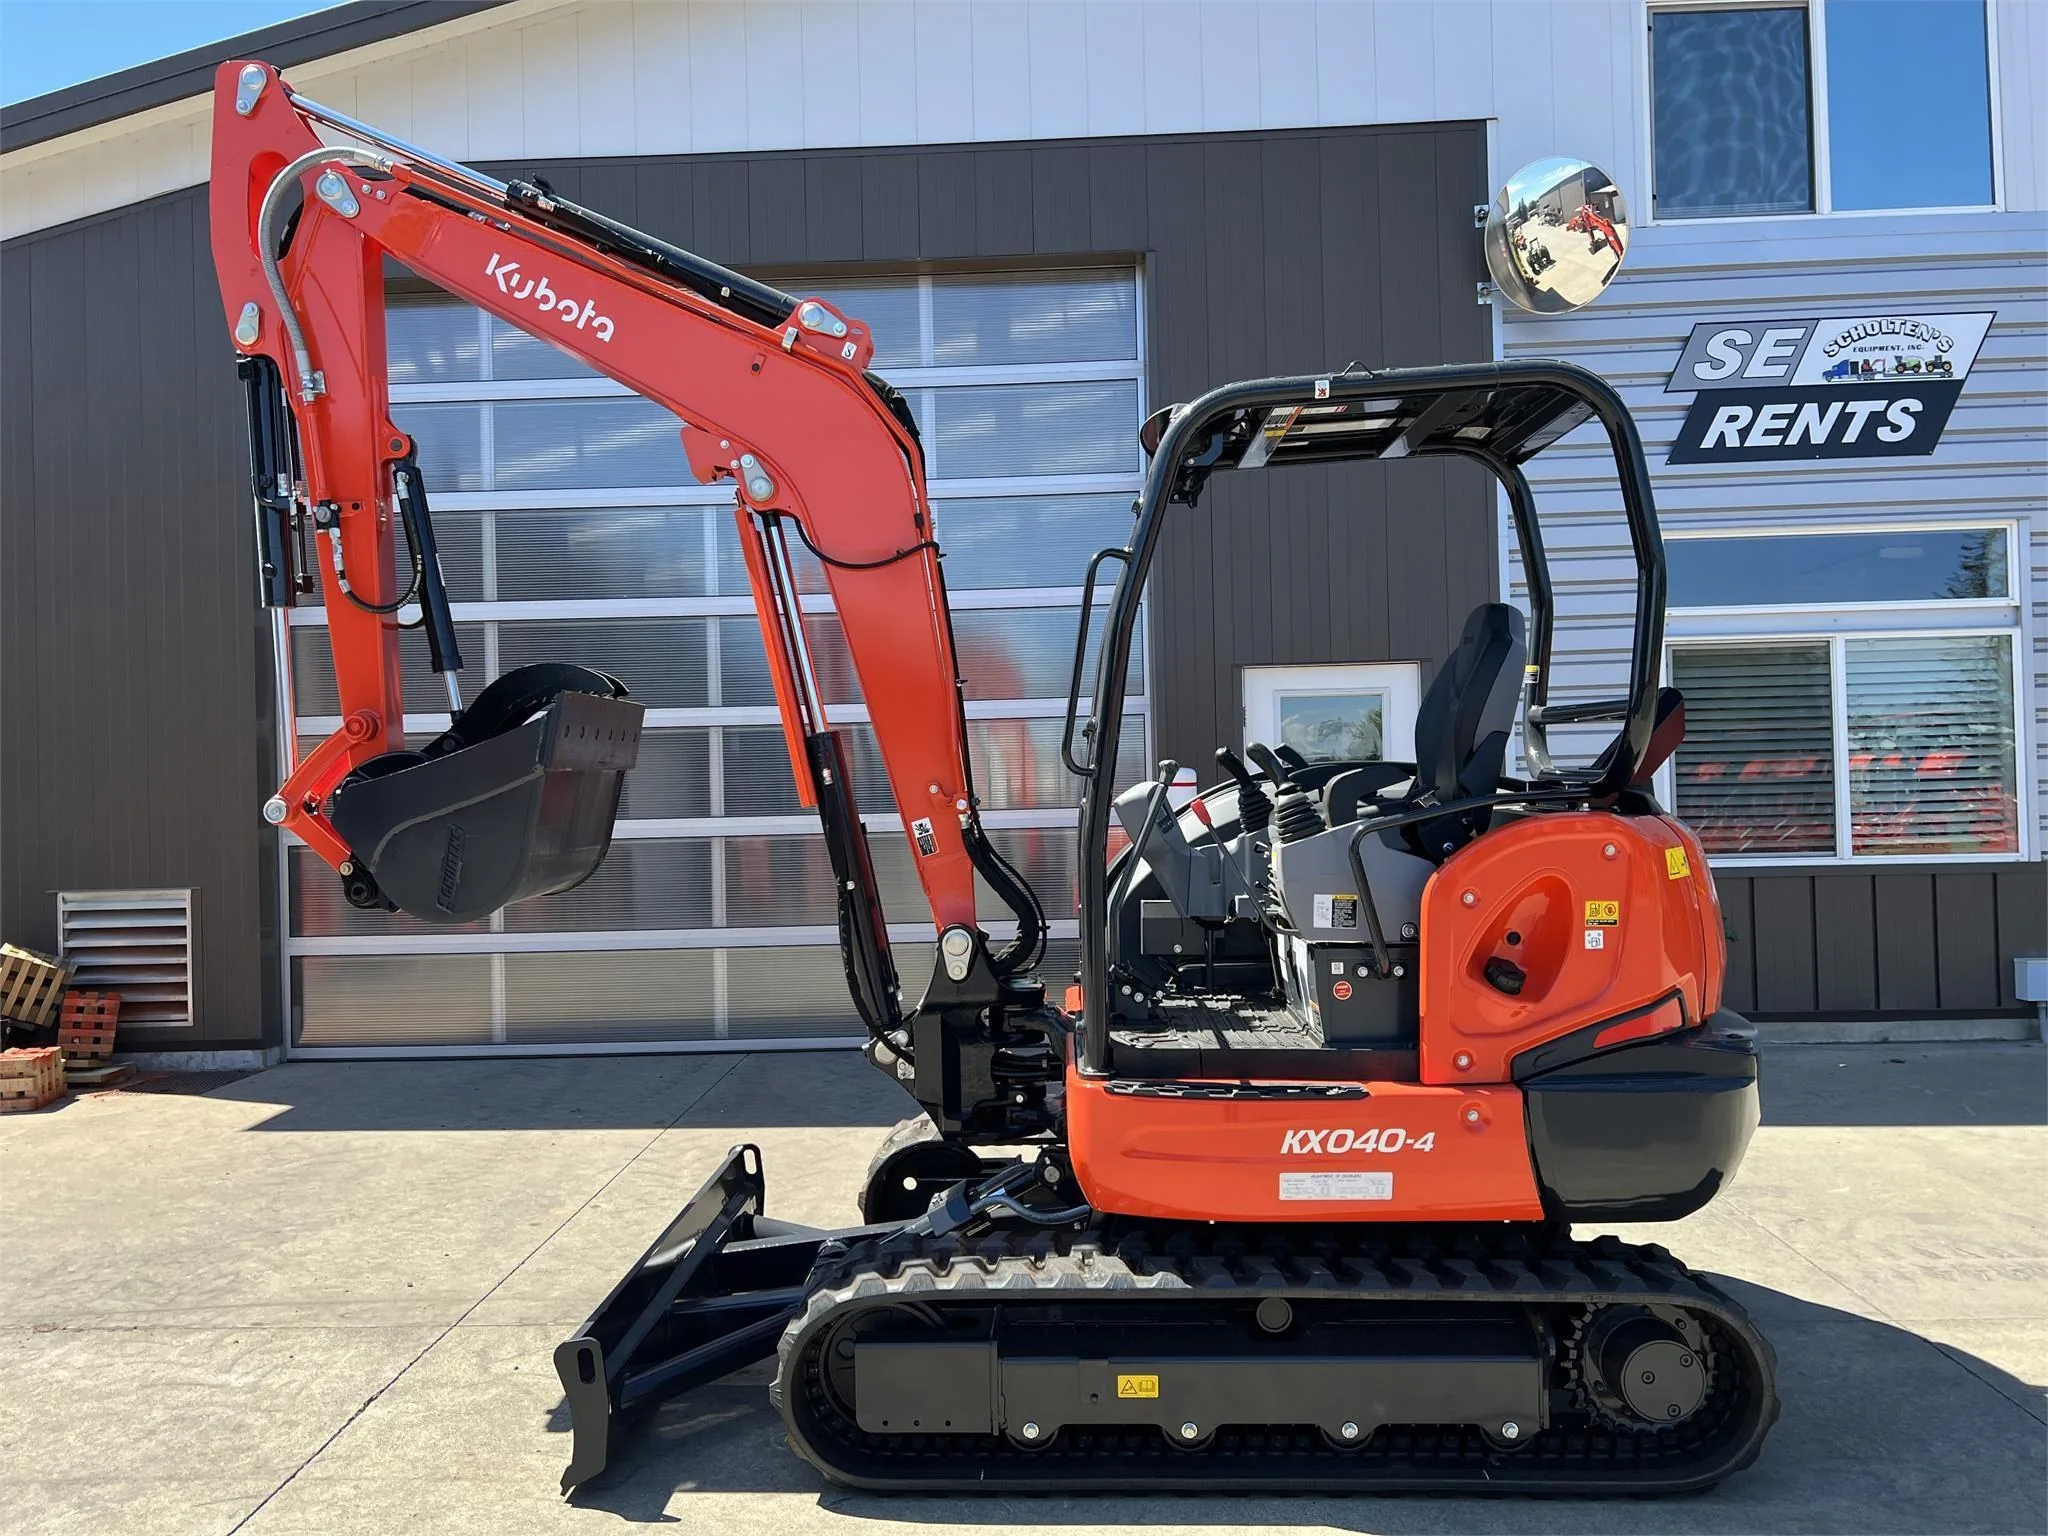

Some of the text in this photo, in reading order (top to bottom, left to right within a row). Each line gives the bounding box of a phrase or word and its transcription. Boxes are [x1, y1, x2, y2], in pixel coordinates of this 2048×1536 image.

[485, 253, 615, 342] Kubota
[1693, 328, 1807, 381] SE
[1823, 319, 1954, 357] SCHOLTEN'S
[1700, 398, 1923, 449] RENTS
[1280, 1129, 1435, 1154] KX040-4
